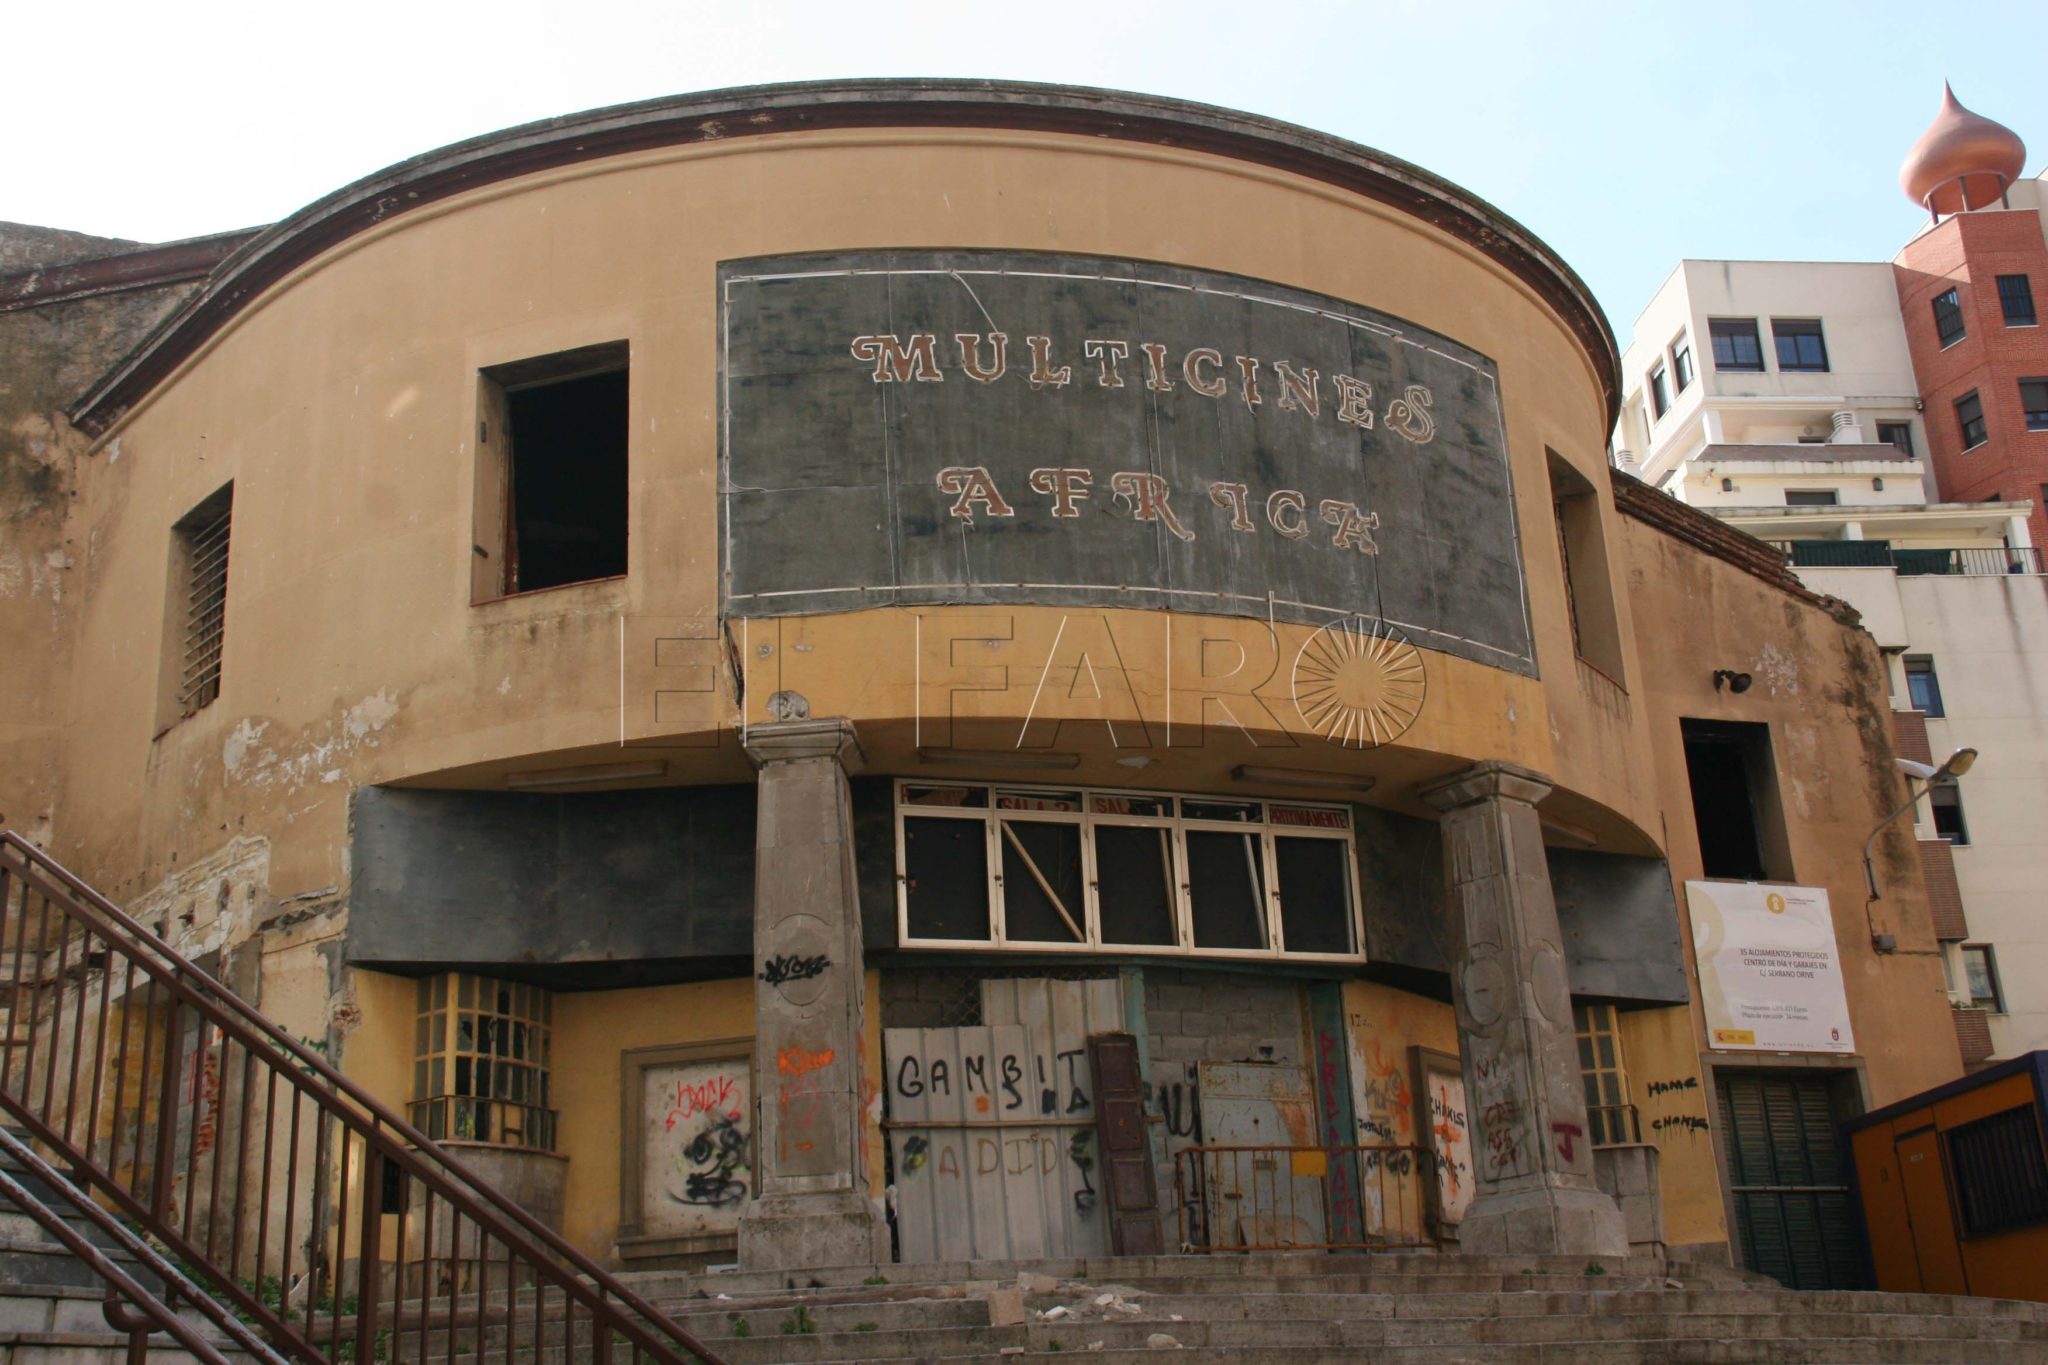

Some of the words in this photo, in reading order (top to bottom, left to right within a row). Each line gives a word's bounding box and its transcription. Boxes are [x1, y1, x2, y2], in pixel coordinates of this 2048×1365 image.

[850, 332, 1435, 444] MULTICINES
[936, 466, 1380, 555] AFRICA
[1767, 959, 1775, 967] DE
